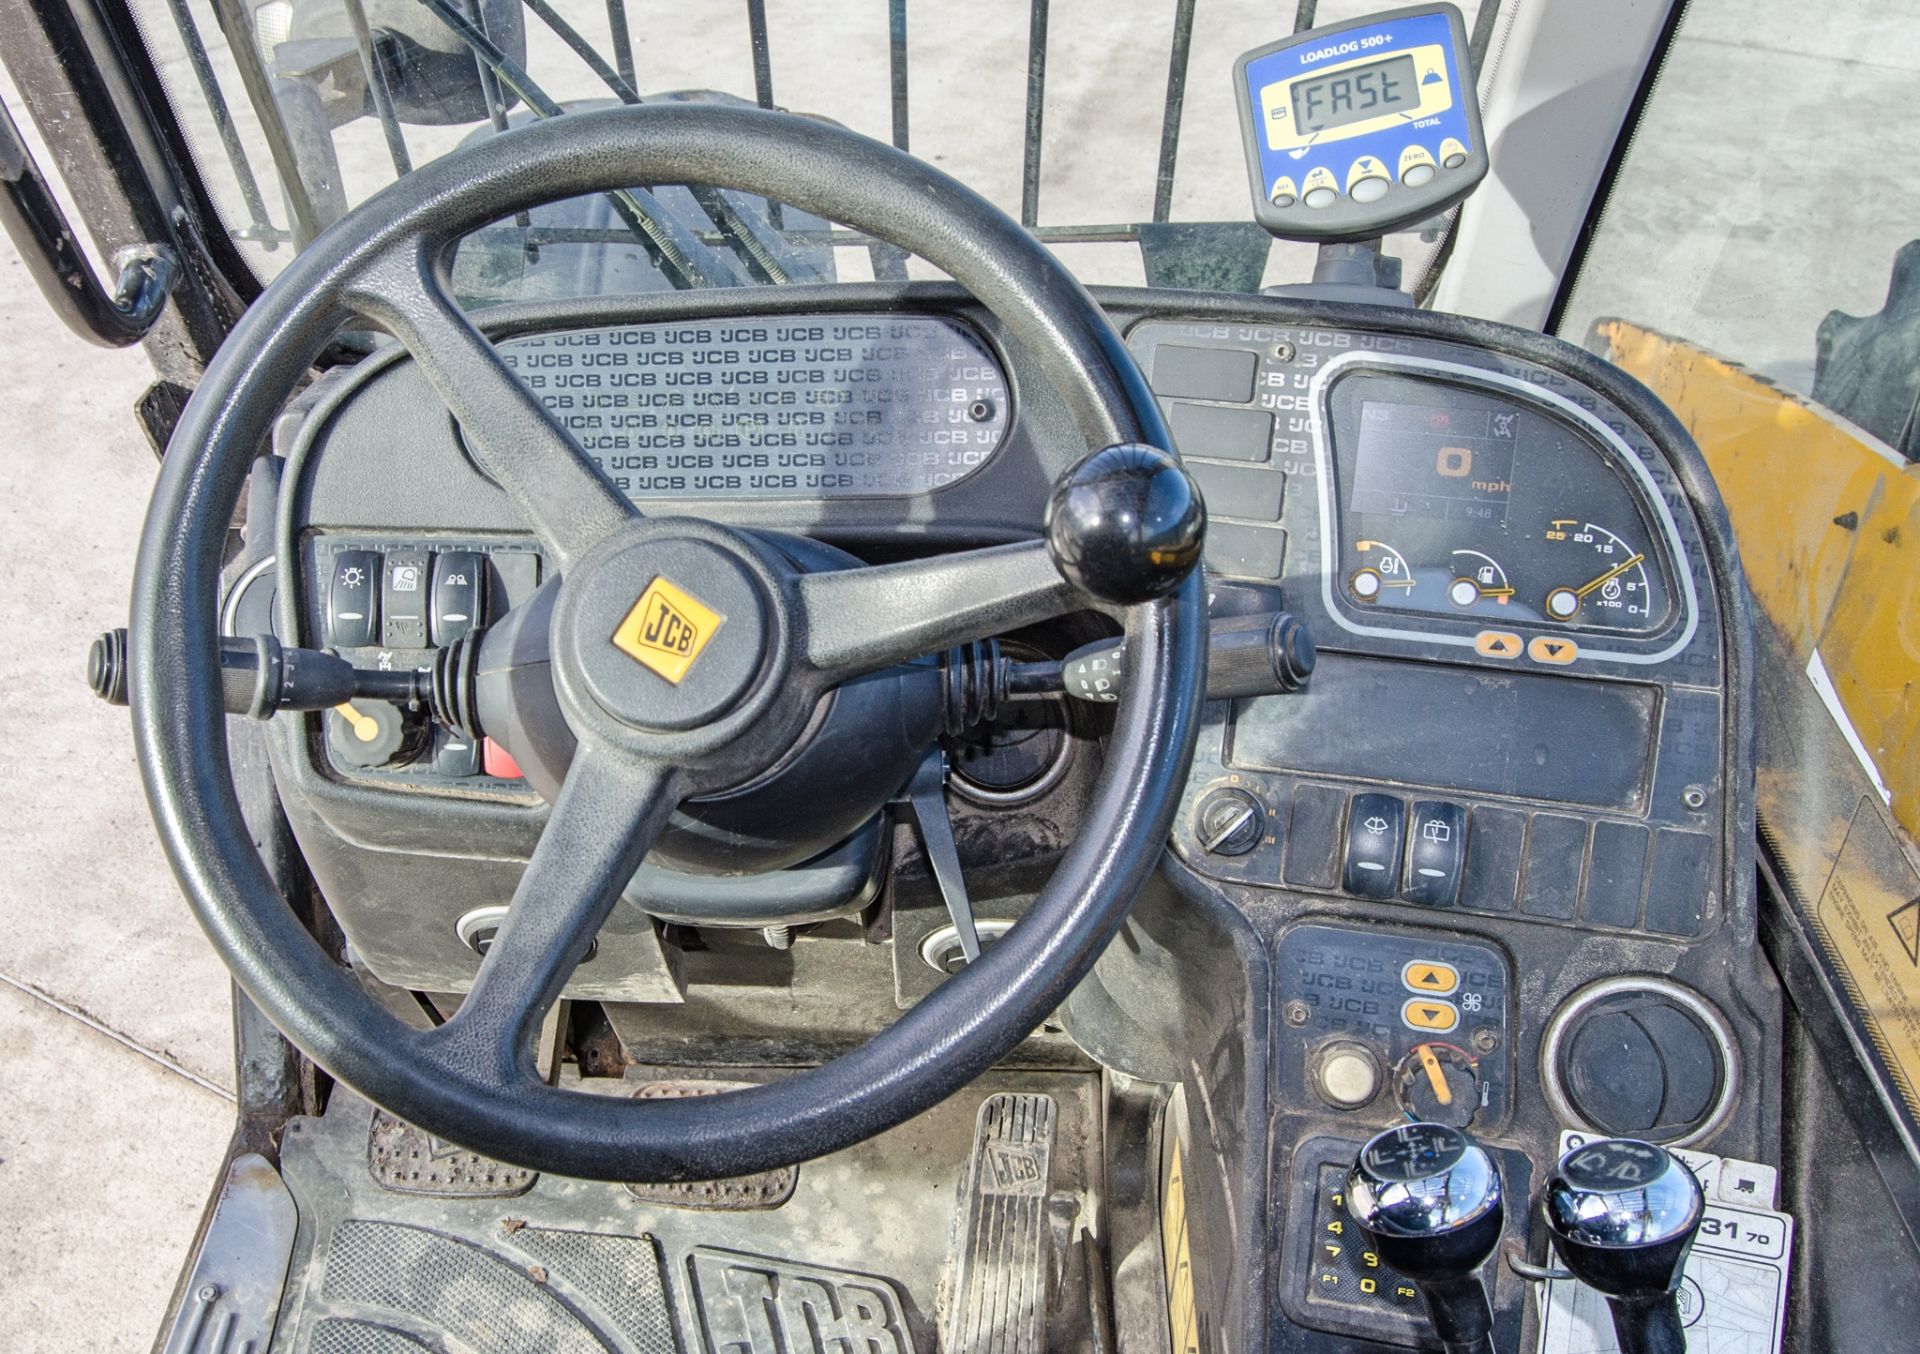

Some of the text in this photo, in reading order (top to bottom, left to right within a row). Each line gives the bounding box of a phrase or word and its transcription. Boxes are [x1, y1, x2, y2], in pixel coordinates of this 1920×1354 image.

[1300, 34, 1393, 65] LOADLOG 500+
[1413, 117, 1441, 129] TOTAL
[1403, 152, 1425, 162] ZERO
[609, 331, 656, 345] JCB
[665, 330, 711, 344] JCB
[721, 329, 767, 343] JCB
[777, 328, 824, 342] JCB
[833, 327, 881, 340] JCB
[1239, 328, 1290, 343] JCB
[1300, 331, 1351, 347] JCB
[527, 354, 573, 367] JCB
[582, 353, 628, 366] JCB
[637, 352, 684, 365] JCB
[693, 351, 740, 364] JCB
[749, 350, 796, 363] JCB
[805, 349, 852, 362] JCB
[555, 374, 601, 388] JCB
[610, 373, 657, 387] JCB
[665, 372, 712, 386] JCB
[721, 371, 768, 385] JCB
[777, 370, 824, 383] JCB
[834, 369, 881, 383] JCB
[949, 366, 996, 381] JCB
[542, 395, 574, 409] CB
[583, 394, 629, 408] JCB
[638, 393, 684, 407] JCB
[693, 392, 740, 406] JCB
[749, 391, 796, 405] JCB
[611, 415, 657, 428] JCB
[666, 413, 713, 427] JCB
[722, 412, 768, 426] JCB
[777, 412, 824, 425] JCB
[583, 435, 630, 449] JCB
[639, 434, 685, 448] JCB
[694, 434, 741, 447] JCB
[750, 433, 797, 447] JCB
[806, 432, 853, 446] JCB
[611, 456, 658, 470] JCB
[667, 455, 713, 469] JCB
[722, 454, 769, 468] JCB
[778, 453, 825, 467] JCB
[1436, 446, 1511, 493] 0 mph
[639, 476, 685, 490] JCB
[694, 475, 741, 489] JCB
[750, 474, 797, 488] JCB
[806, 474, 854, 487] JCB
[1466, 507, 1492, 518] 9:48
[1546, 531, 1566, 540] 25
[1573, 533, 1593, 543] 20
[1594, 544, 1614, 554] 15
[1626, 582, 1636, 591] 5
[1596, 600, 1622, 608] x100
[1628, 605, 1638, 614] 0
[644, 602, 693, 652] JCB
[1302, 971, 1352, 990] JCB
[1329, 996, 1380, 1015] JCB
[1000, 1152, 1041, 1184] JCB
[1332, 1194, 1342, 1206] 1
[1327, 1220, 1343, 1235] 4
[1746, 1232, 1770, 1245] 70
[1325, 1245, 1341, 1257] 7
[1363, 1252, 1379, 1268] 9
[1322, 1274, 1338, 1284] F1
[1360, 1278, 1376, 1293] 0
[1397, 1286, 1415, 1298] F2
